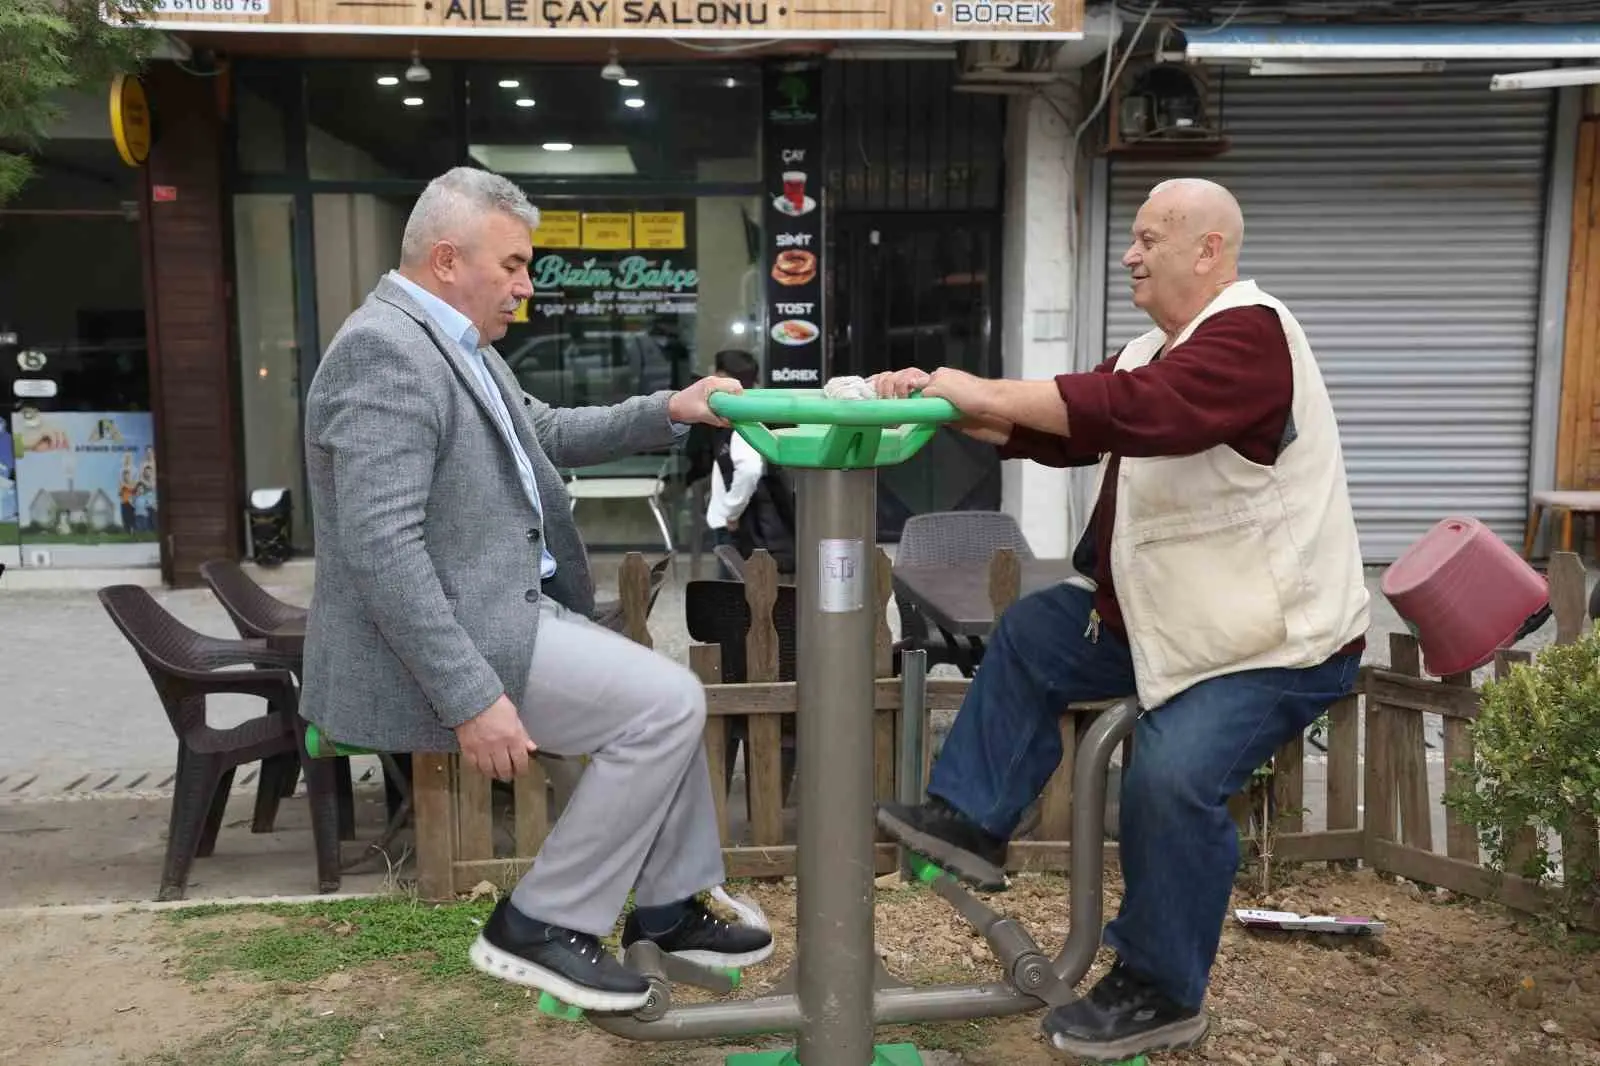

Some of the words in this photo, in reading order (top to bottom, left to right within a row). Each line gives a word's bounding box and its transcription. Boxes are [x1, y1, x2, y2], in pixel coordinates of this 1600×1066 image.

[174, 0, 205, 10] 610
[213, 0, 234, 11] 80
[242, 0, 263, 11] 76
[954, 0, 1052, 23] BÖREK
[542, 1, 609, 28] ÇAY
[623, 1, 769, 25] SALONU
[781, 149, 807, 165] ÇAY
[532, 254, 613, 289] Bizim
[614, 255, 700, 292] Bahçe
[774, 302, 815, 315] TOST
[771, 366, 819, 382] BÖREK
